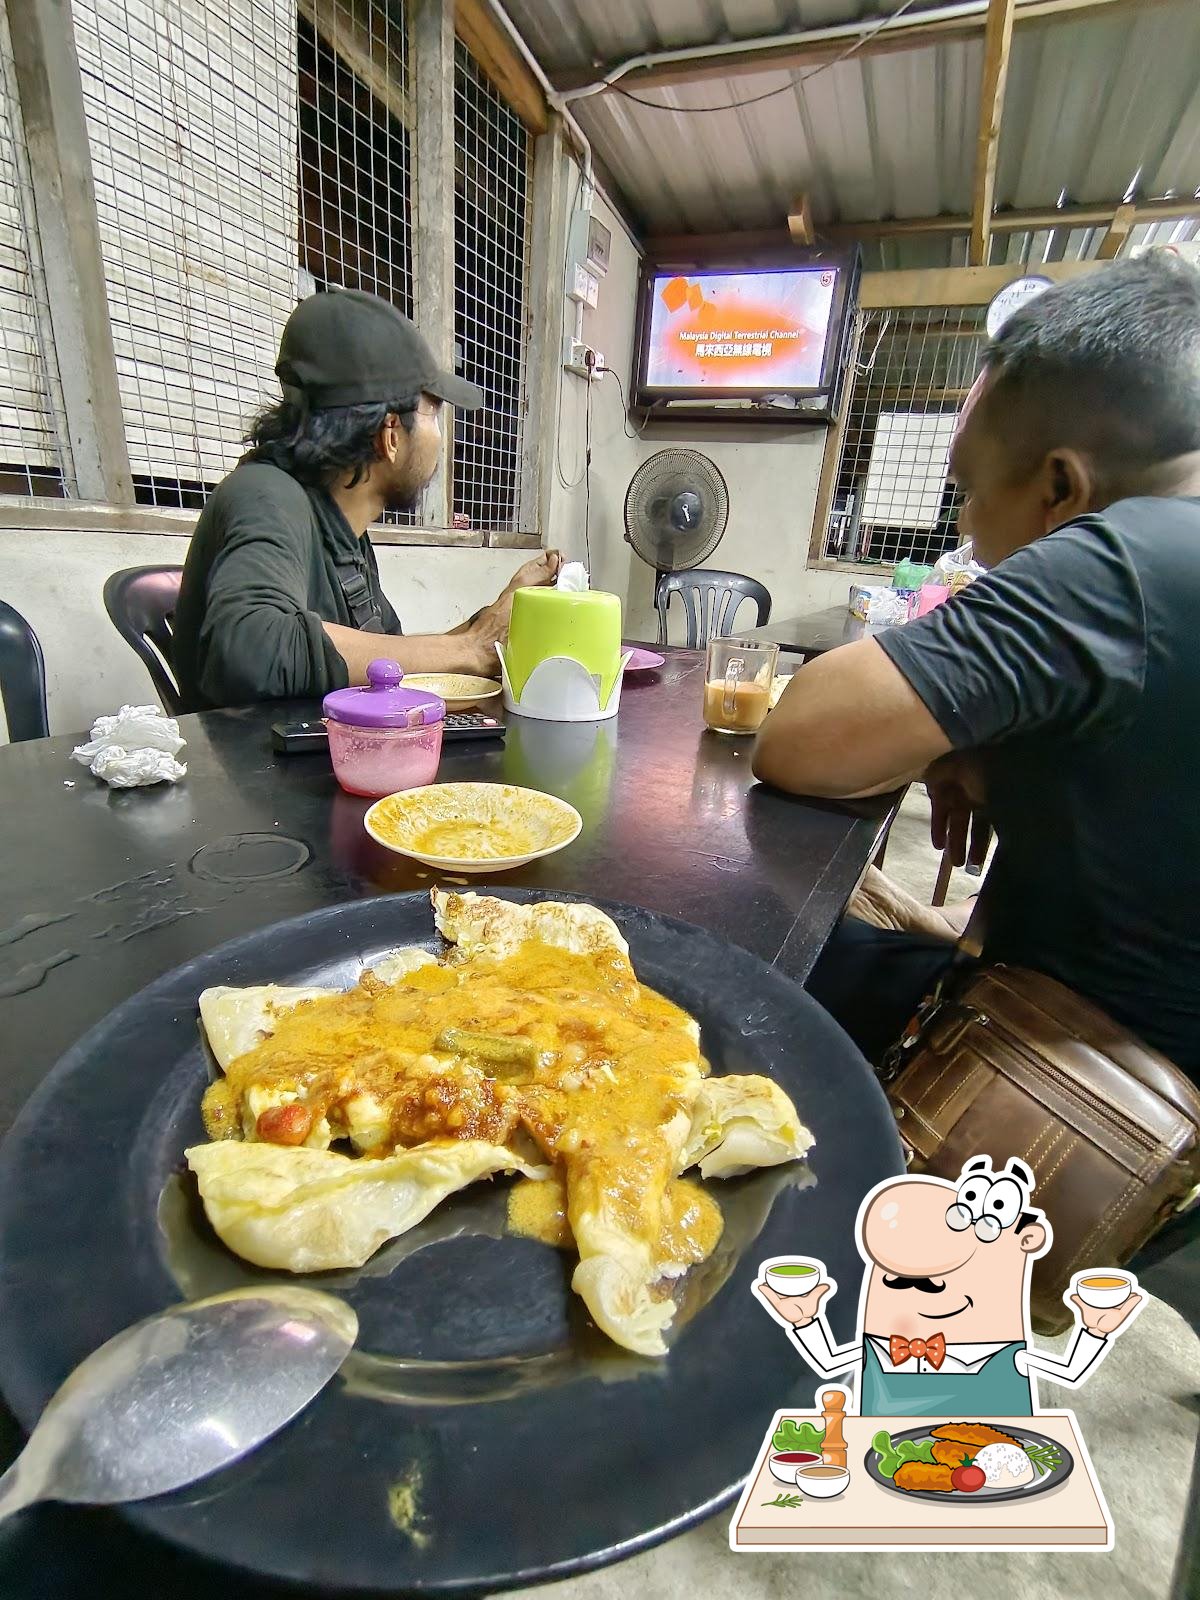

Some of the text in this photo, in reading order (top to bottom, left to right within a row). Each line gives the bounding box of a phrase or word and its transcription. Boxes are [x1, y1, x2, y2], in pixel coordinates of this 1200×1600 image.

[679, 330, 799, 342] Malaysia Digital Terrestrial Channel
